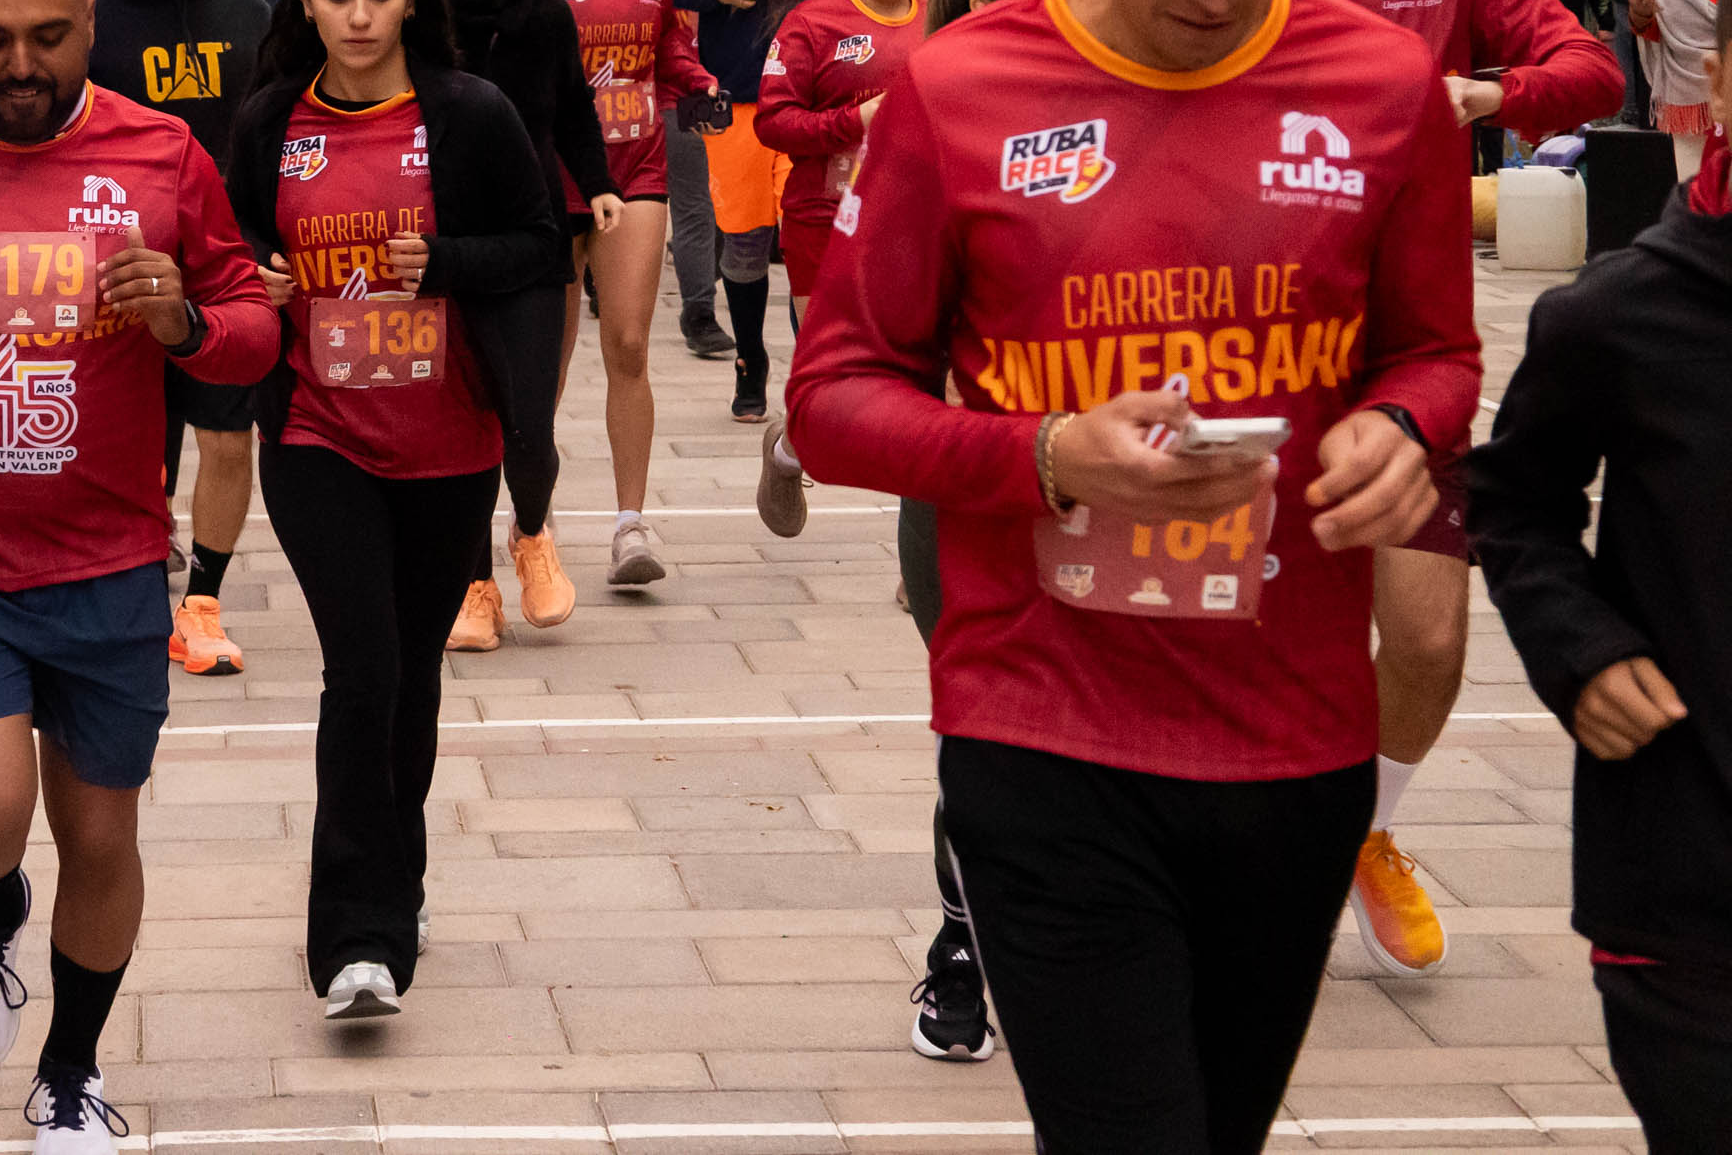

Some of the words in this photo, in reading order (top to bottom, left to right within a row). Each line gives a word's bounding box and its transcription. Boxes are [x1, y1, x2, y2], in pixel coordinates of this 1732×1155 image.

[839, 35, 869, 50] RUBA
[602, 91, 644, 122] 196
[281, 137, 322, 156] RUBA
[400, 153, 429, 167] ru
[1009, 124, 1097, 162] RUBA
[1006, 148, 1097, 187] RACE
[1259, 157, 1365, 197] ruba
[68, 204, 140, 227] ruba
[297, 210, 389, 246] CARRERA
[398, 206, 425, 234] DE
[0, 243, 85, 296] 179
[1062, 265, 1236, 330] CARRERA
[1254, 263, 1302, 318] DE
[363, 309, 438, 356] 136
[35, 382, 73, 395] AÑOS
[11, 461, 59, 471] VALOR
